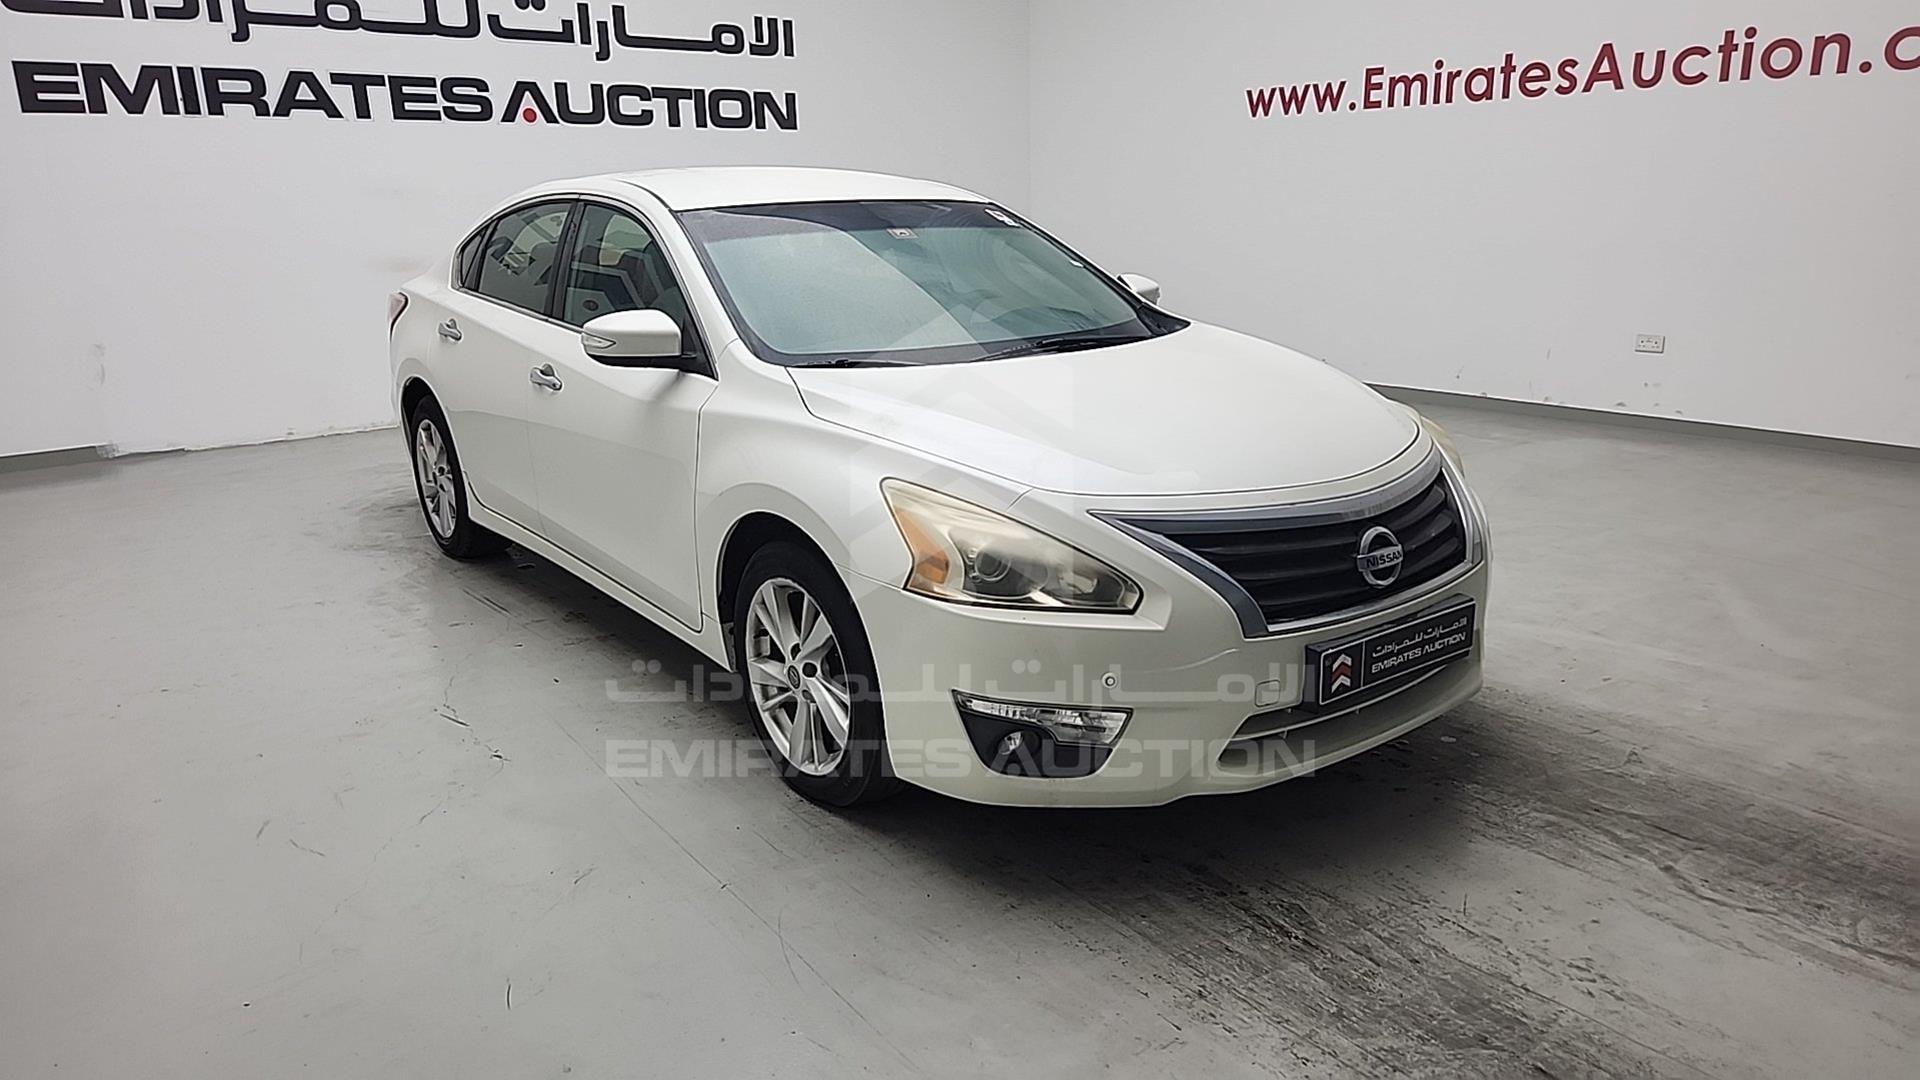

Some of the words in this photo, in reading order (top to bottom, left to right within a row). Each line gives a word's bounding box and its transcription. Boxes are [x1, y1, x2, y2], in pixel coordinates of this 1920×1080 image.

[11, 60, 494, 122] EMIRATES
[500, 80, 798, 130] AUCTION
[1366, 550, 1402, 568] NISSAN
[1371, 647, 1422, 674] EMIRATES
[1423, 631, 1466, 655] AUCTION
